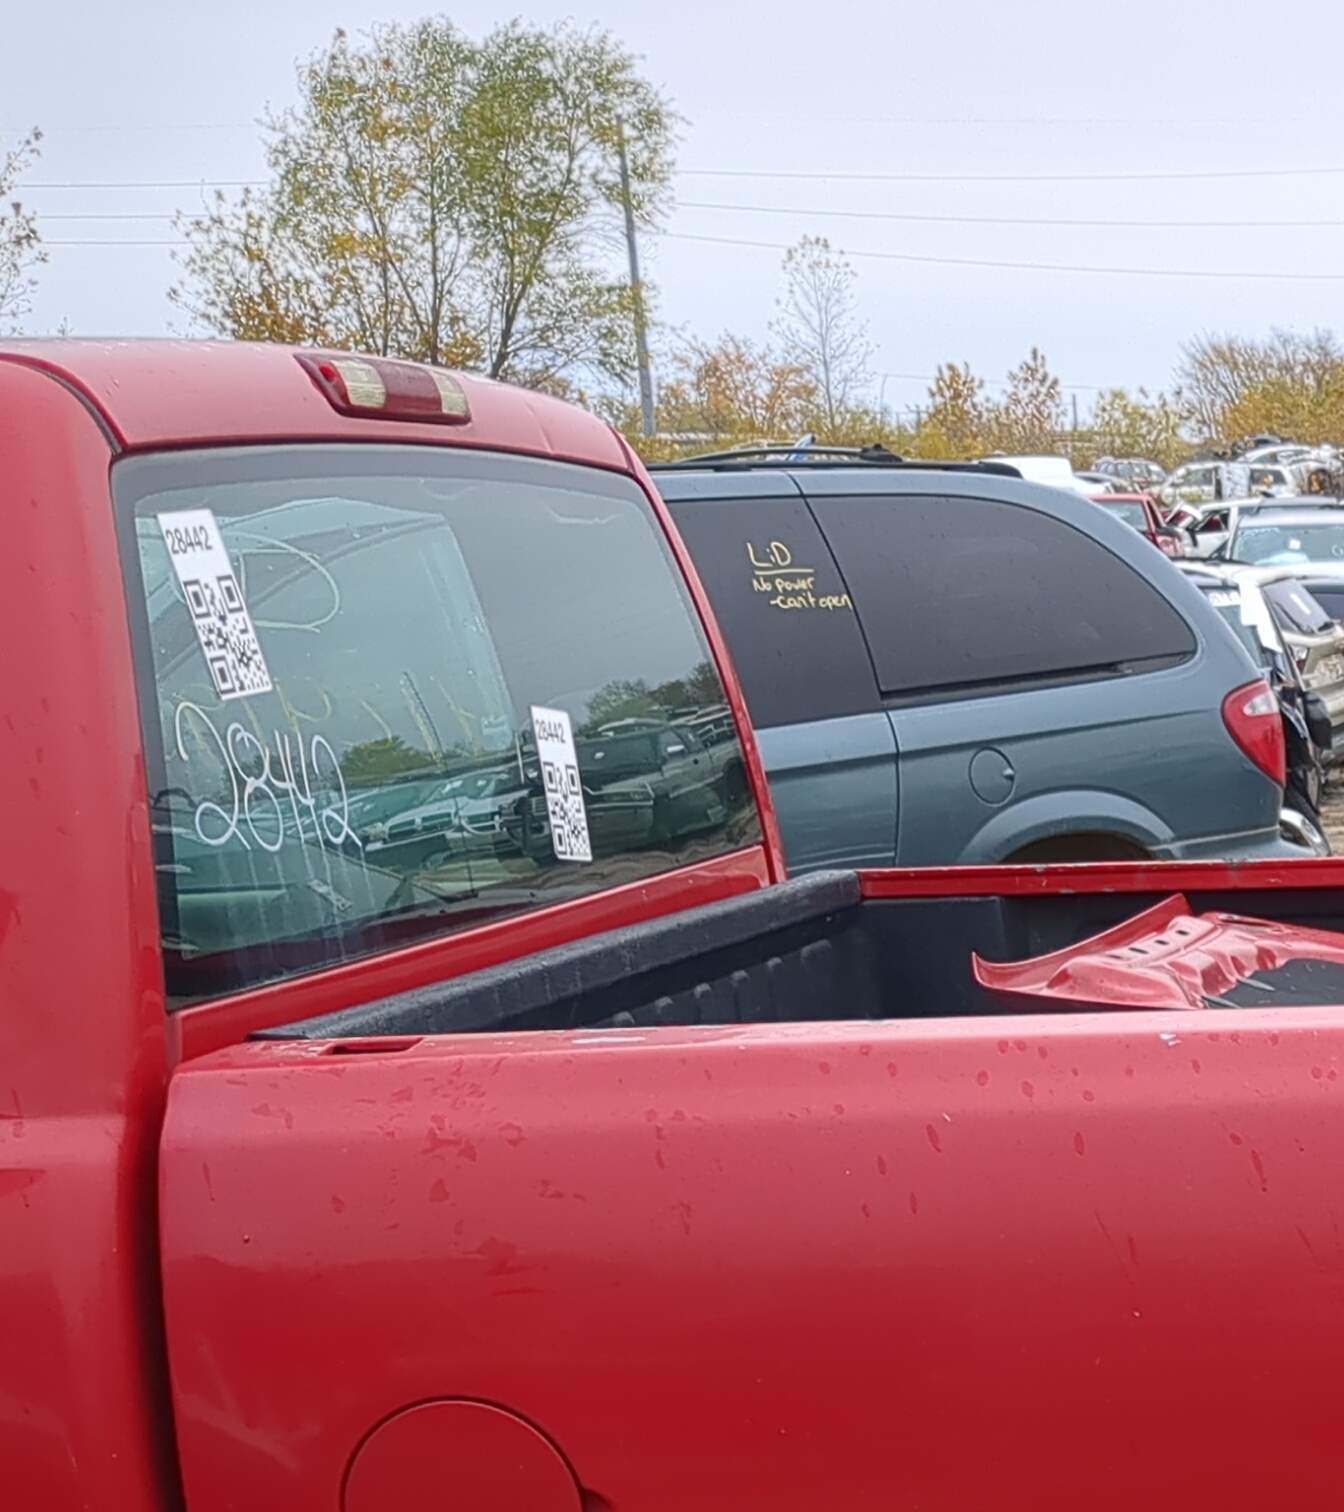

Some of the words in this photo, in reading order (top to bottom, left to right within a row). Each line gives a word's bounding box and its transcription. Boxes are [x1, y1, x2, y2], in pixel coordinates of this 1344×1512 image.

[165, 525, 213, 555] 28442
[752, 576, 773, 593] No
[819, 593, 853, 611] open
[535, 718, 566, 744] 28442
[175, 701, 363, 852] 28442
